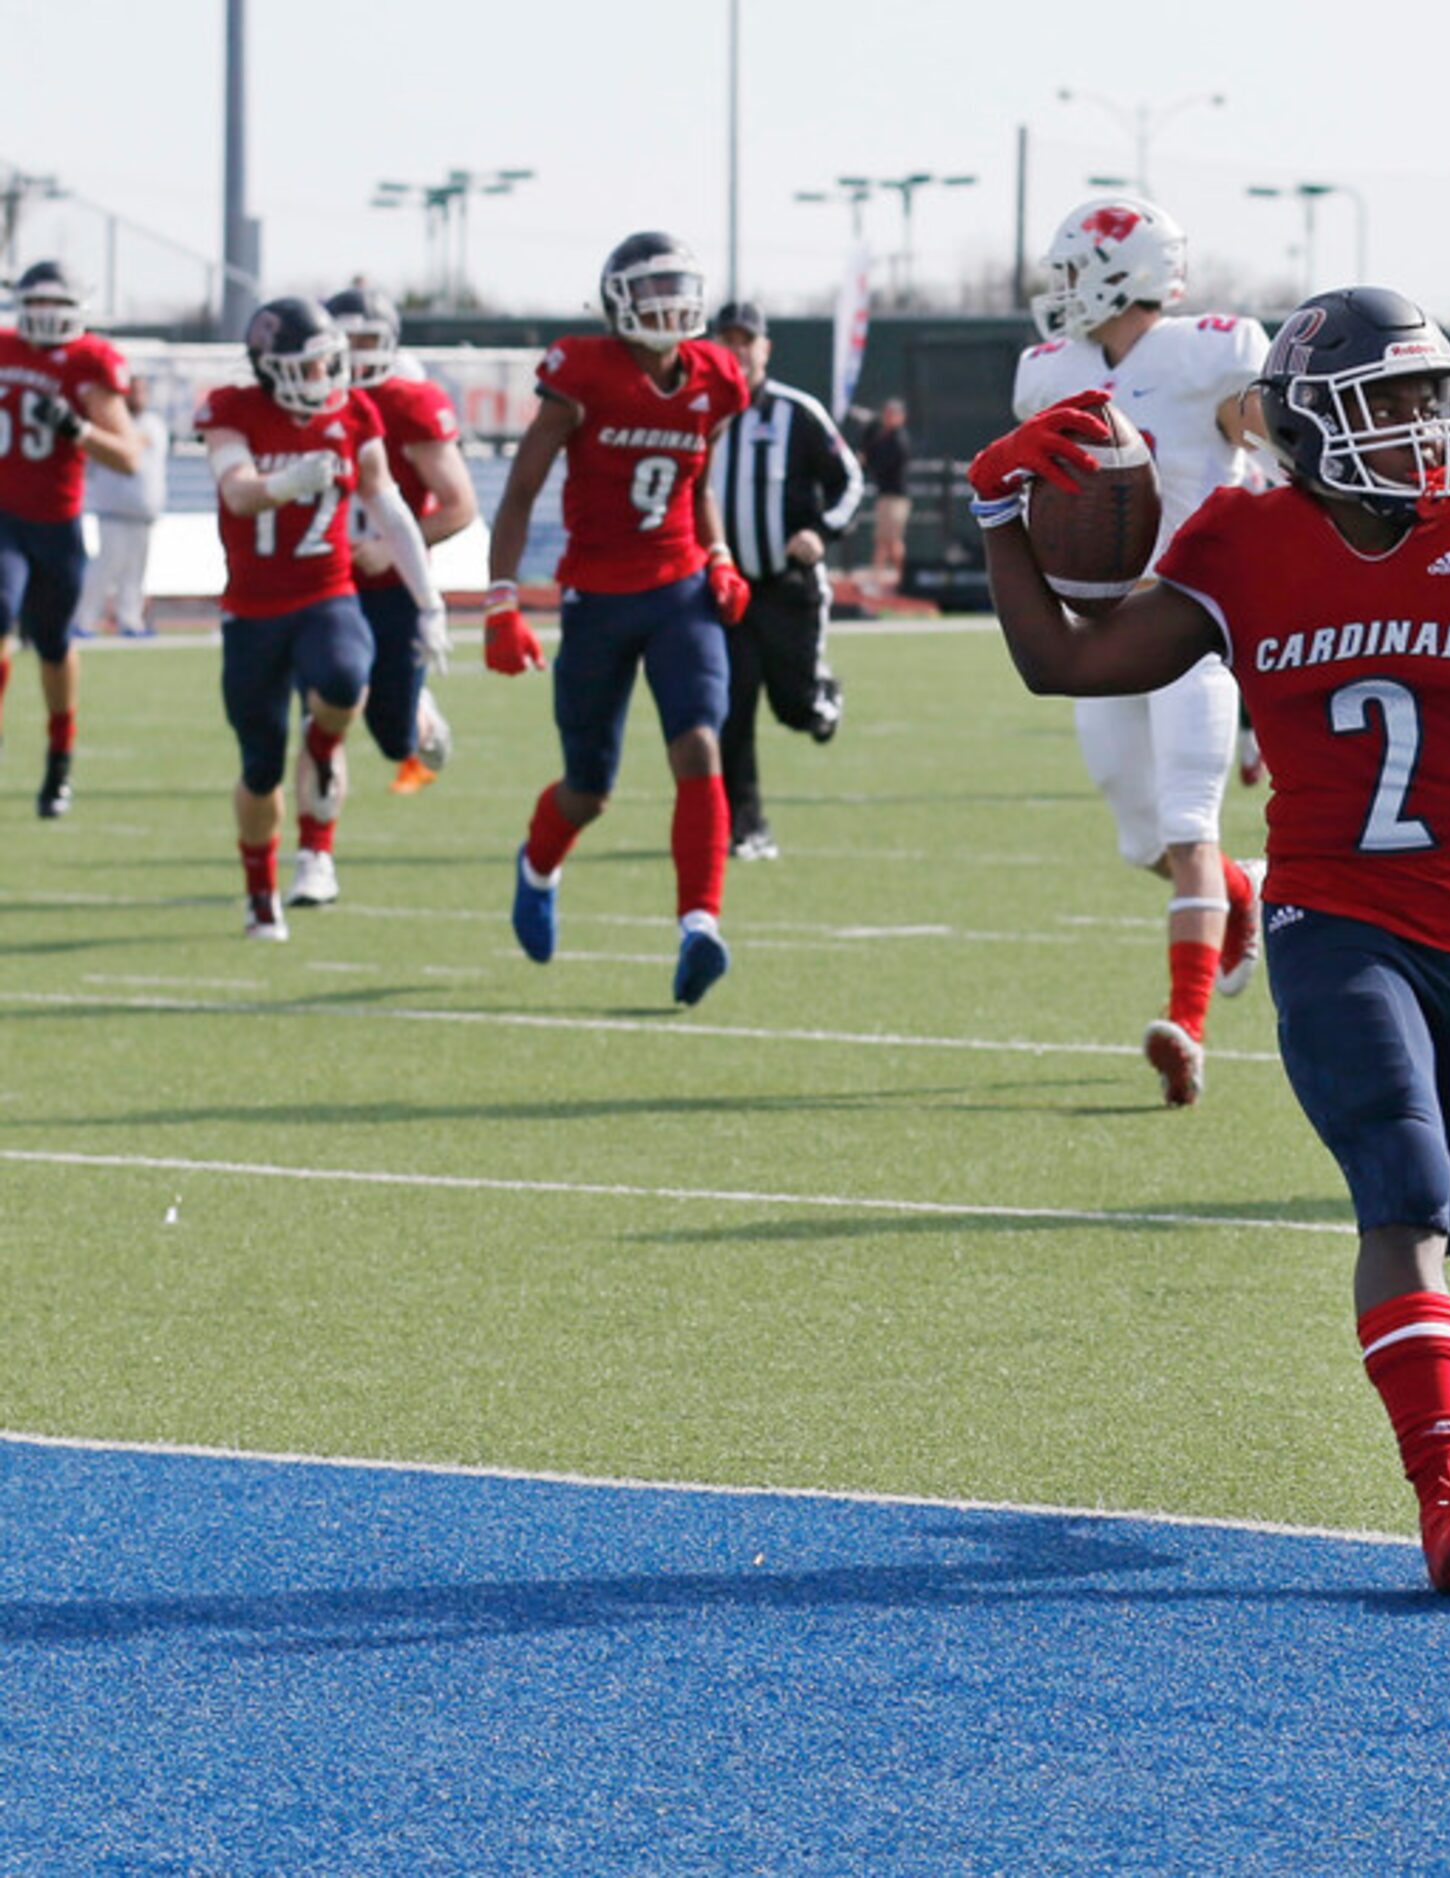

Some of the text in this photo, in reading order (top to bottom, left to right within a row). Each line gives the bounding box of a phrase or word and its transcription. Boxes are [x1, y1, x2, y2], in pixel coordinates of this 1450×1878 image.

[598, 426, 706, 453] CARDINAL
[630, 455, 679, 532] 9
[1327, 676, 1440, 854] 2
